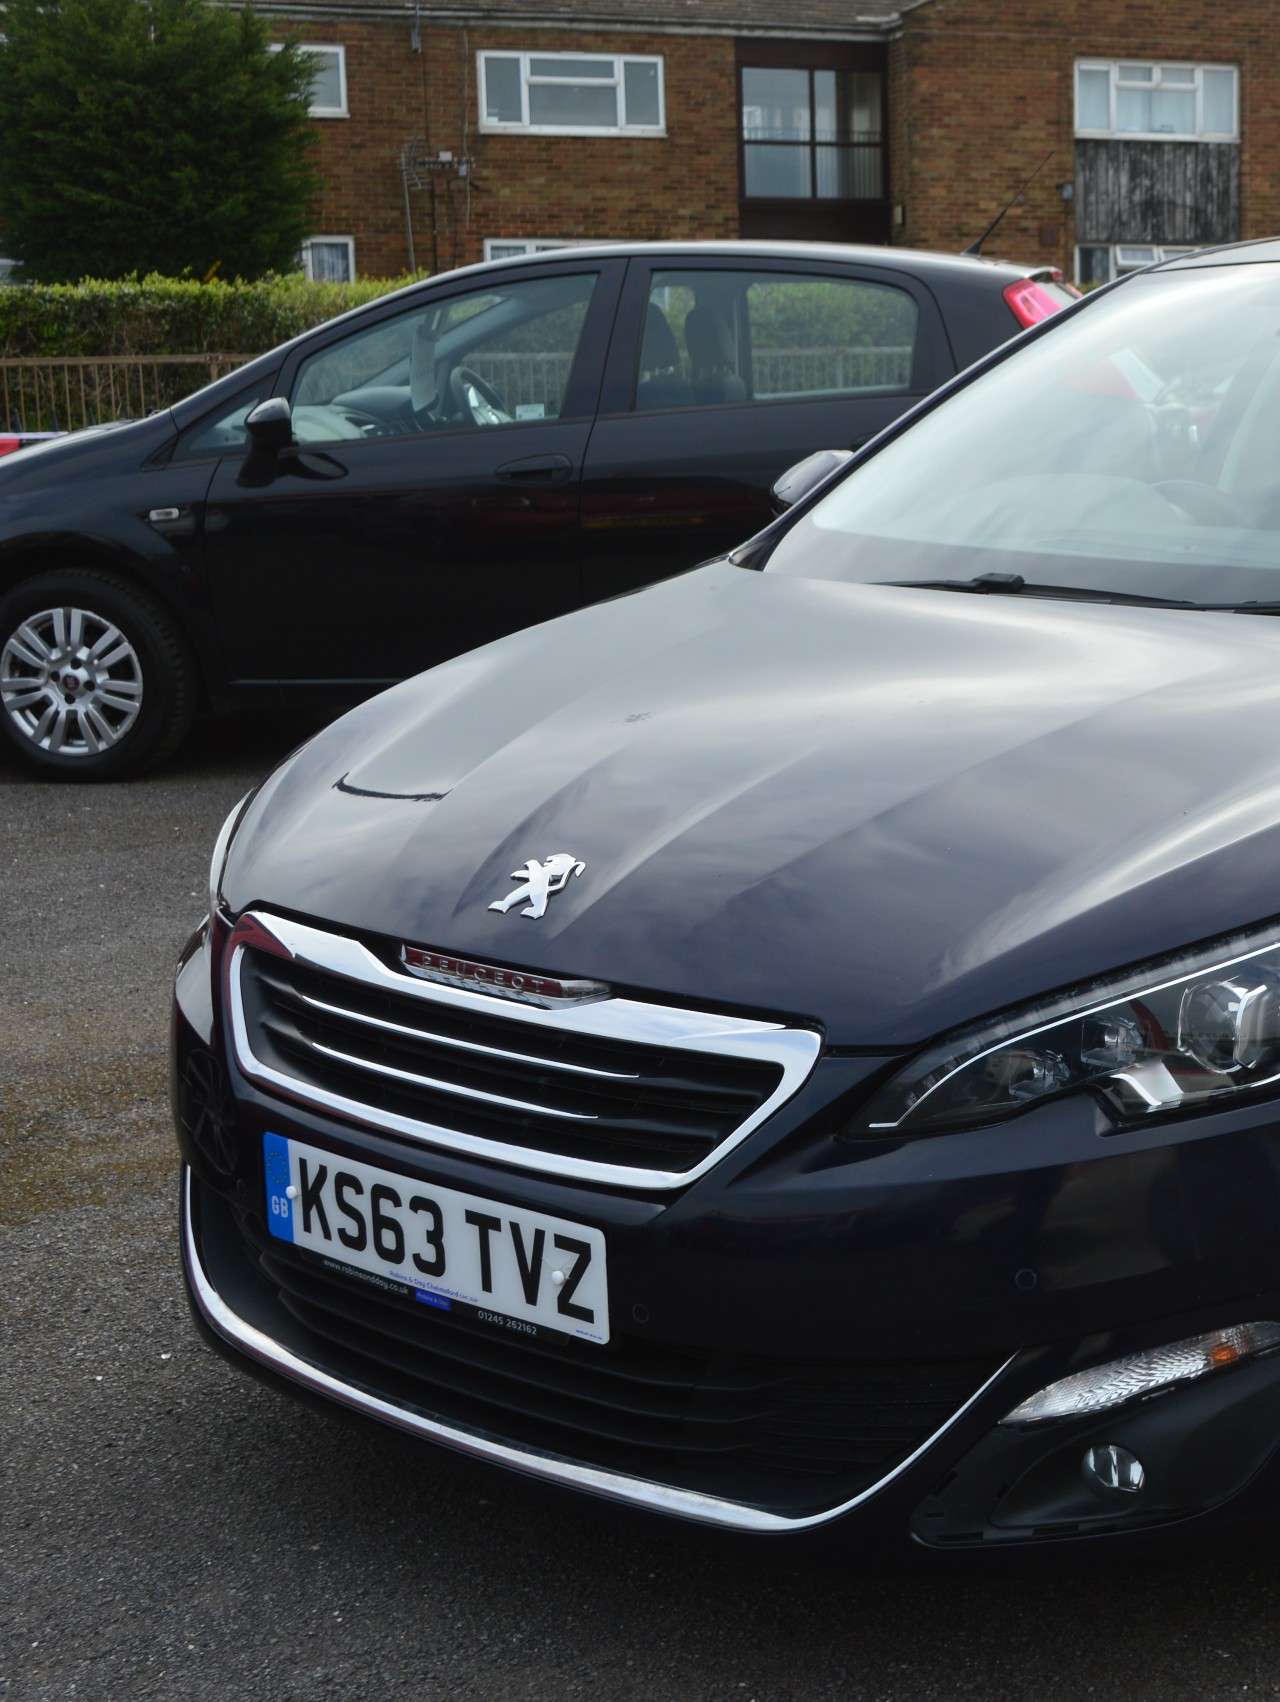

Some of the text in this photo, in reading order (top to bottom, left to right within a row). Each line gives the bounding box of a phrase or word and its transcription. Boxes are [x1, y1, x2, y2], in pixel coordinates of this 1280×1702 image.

[422, 955, 545, 993] PEUGEOT
[271, 1195, 289, 1219] GB
[298, 1156, 595, 1325] KS63 TVZ
